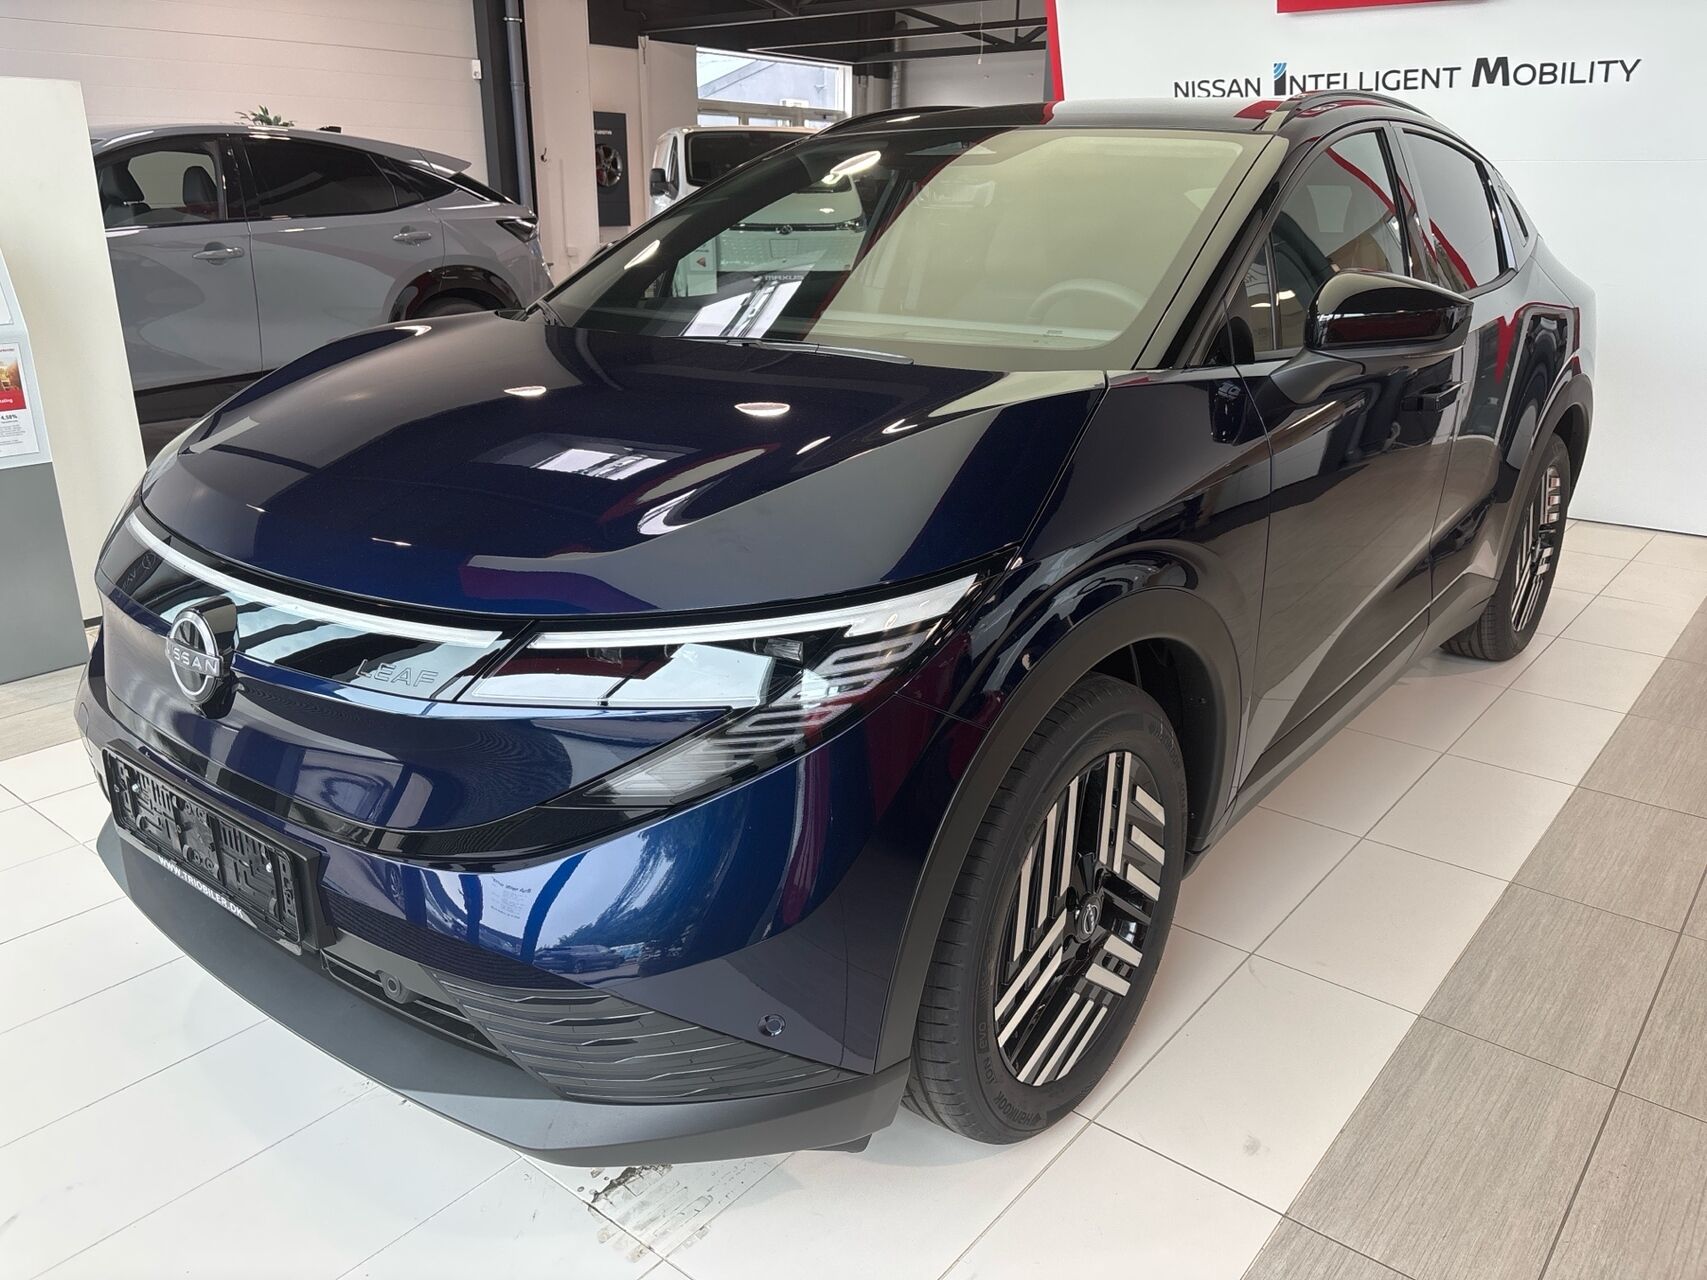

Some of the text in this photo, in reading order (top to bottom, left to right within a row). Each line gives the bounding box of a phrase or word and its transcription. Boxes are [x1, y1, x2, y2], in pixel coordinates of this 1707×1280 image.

[1173, 56, 1642, 98] NISSAN INTELLIGENT MOBILITY
[354, 659, 439, 687] LEAF
[158, 855, 244, 919] WWW.TRIOBILER.DK
